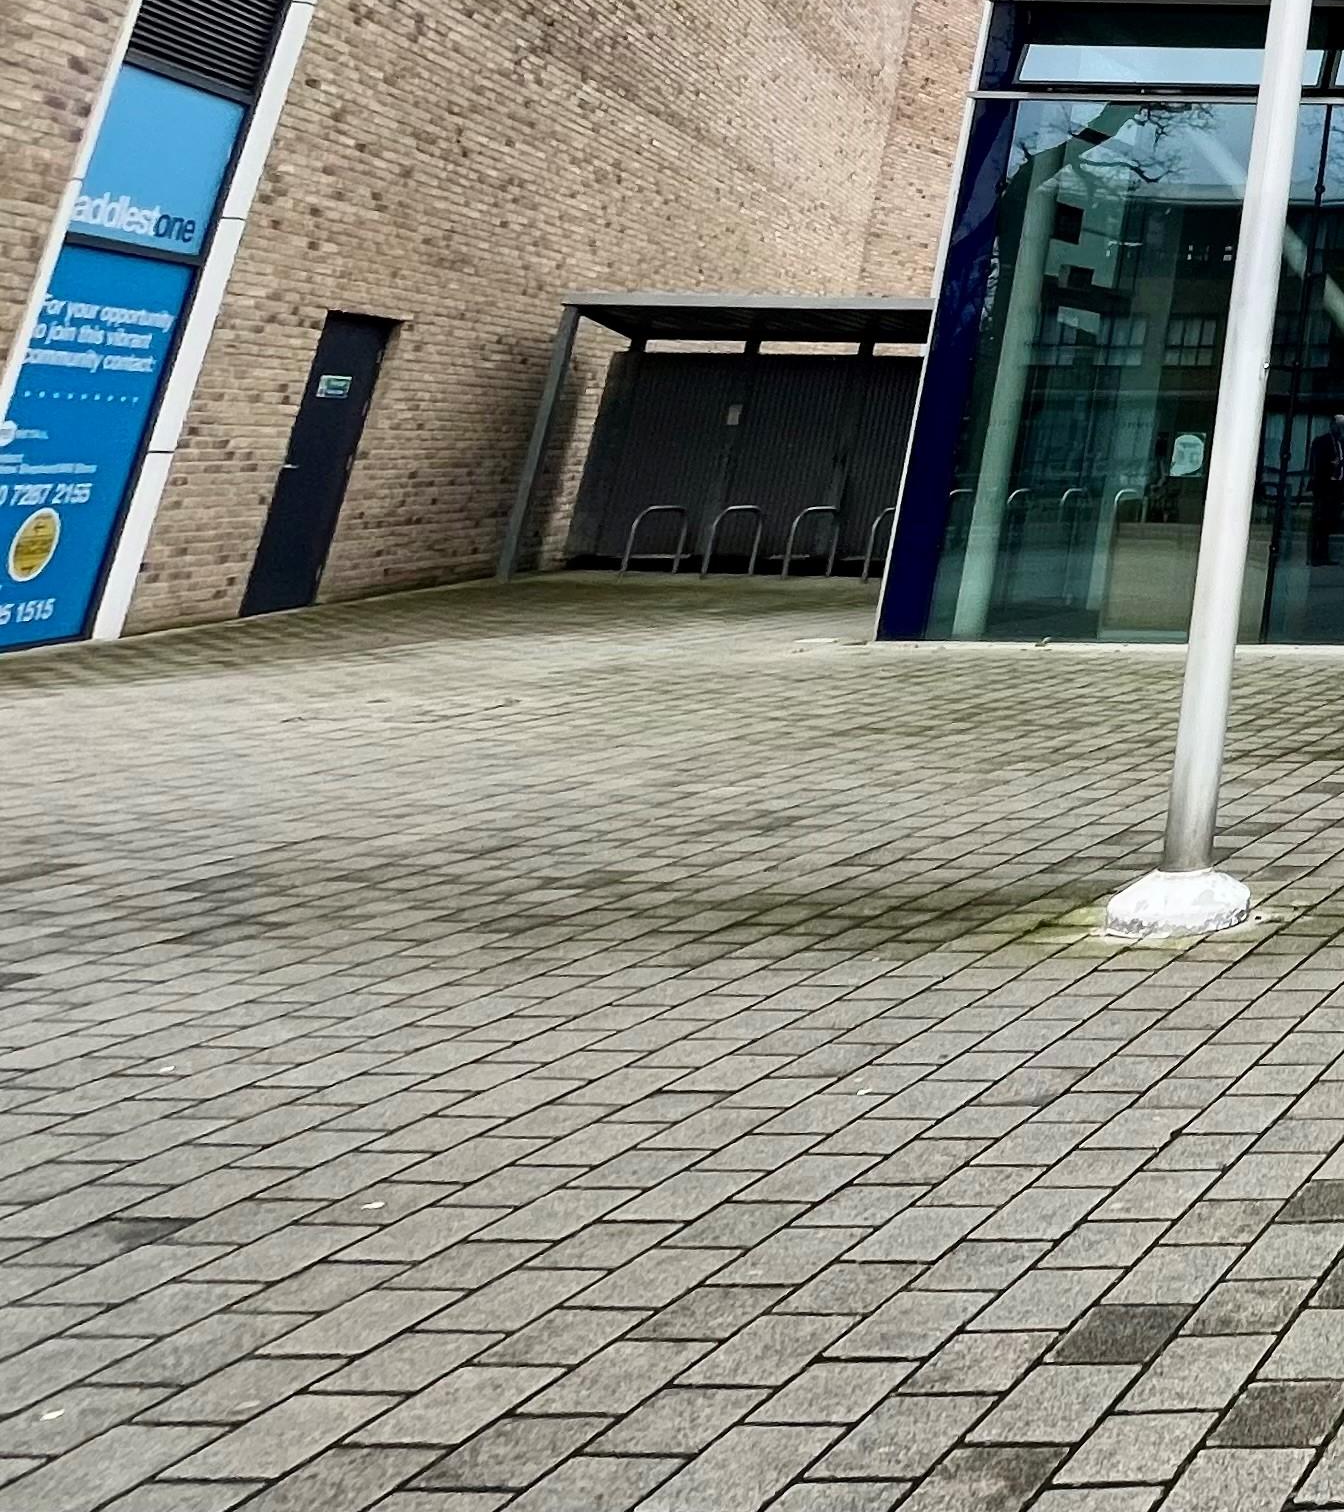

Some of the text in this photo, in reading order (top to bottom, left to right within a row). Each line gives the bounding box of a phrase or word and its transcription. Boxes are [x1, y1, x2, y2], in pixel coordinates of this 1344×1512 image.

[71, 191, 196, 243] addlestone
[33, 323, 47, 339] o
[65, 301, 101, 327] your
[100, 306, 177, 334] opportunity
[16, 598, 57, 624] 1515
